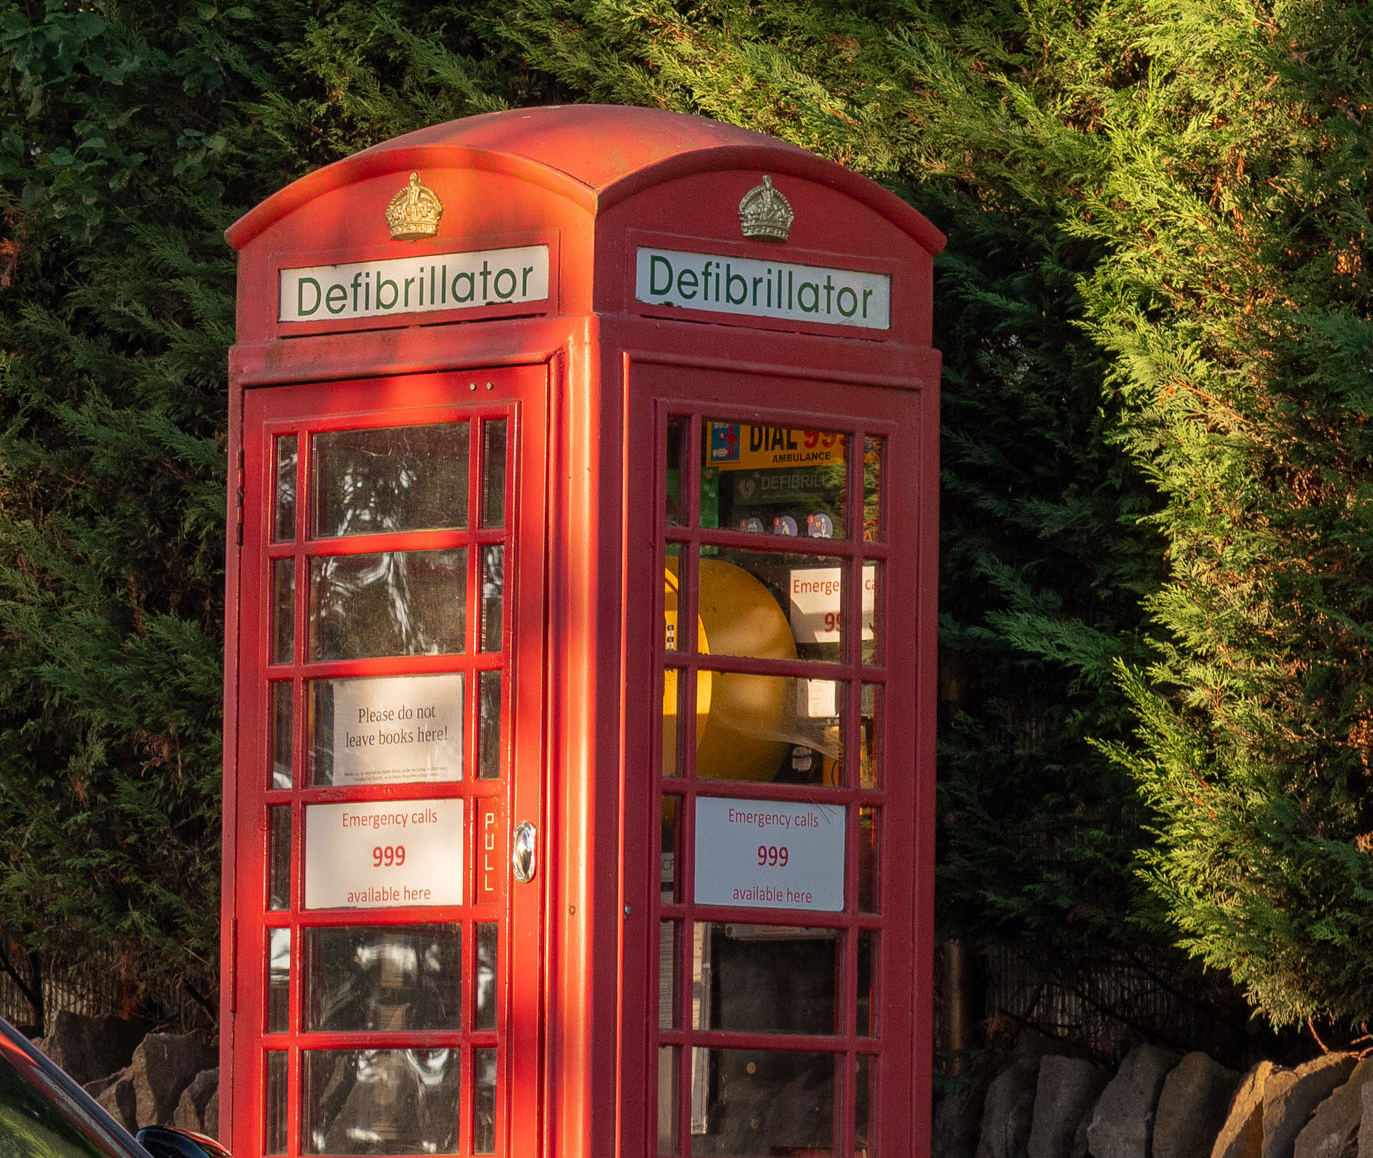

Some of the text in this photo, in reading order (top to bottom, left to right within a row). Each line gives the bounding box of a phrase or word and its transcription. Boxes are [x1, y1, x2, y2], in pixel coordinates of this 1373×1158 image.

[298, 261, 534, 317] Defibrillator
[650, 255, 874, 319] Defibrillator
[772, 451, 831, 463] AMBULANCE
[793, 580, 840, 596] Emerge
[358, 705, 436, 723] Please do not
[346, 726, 448, 748] leave books here!
[342, 808, 438, 829] Emergency calls
[728, 808, 819, 829] Emergency calls
[372, 845, 405, 867] 999
[484, 812, 495, 891] PULL
[757, 845, 789, 867] 999
[347, 886, 431, 903] available here
[733, 886, 812, 903] available here
